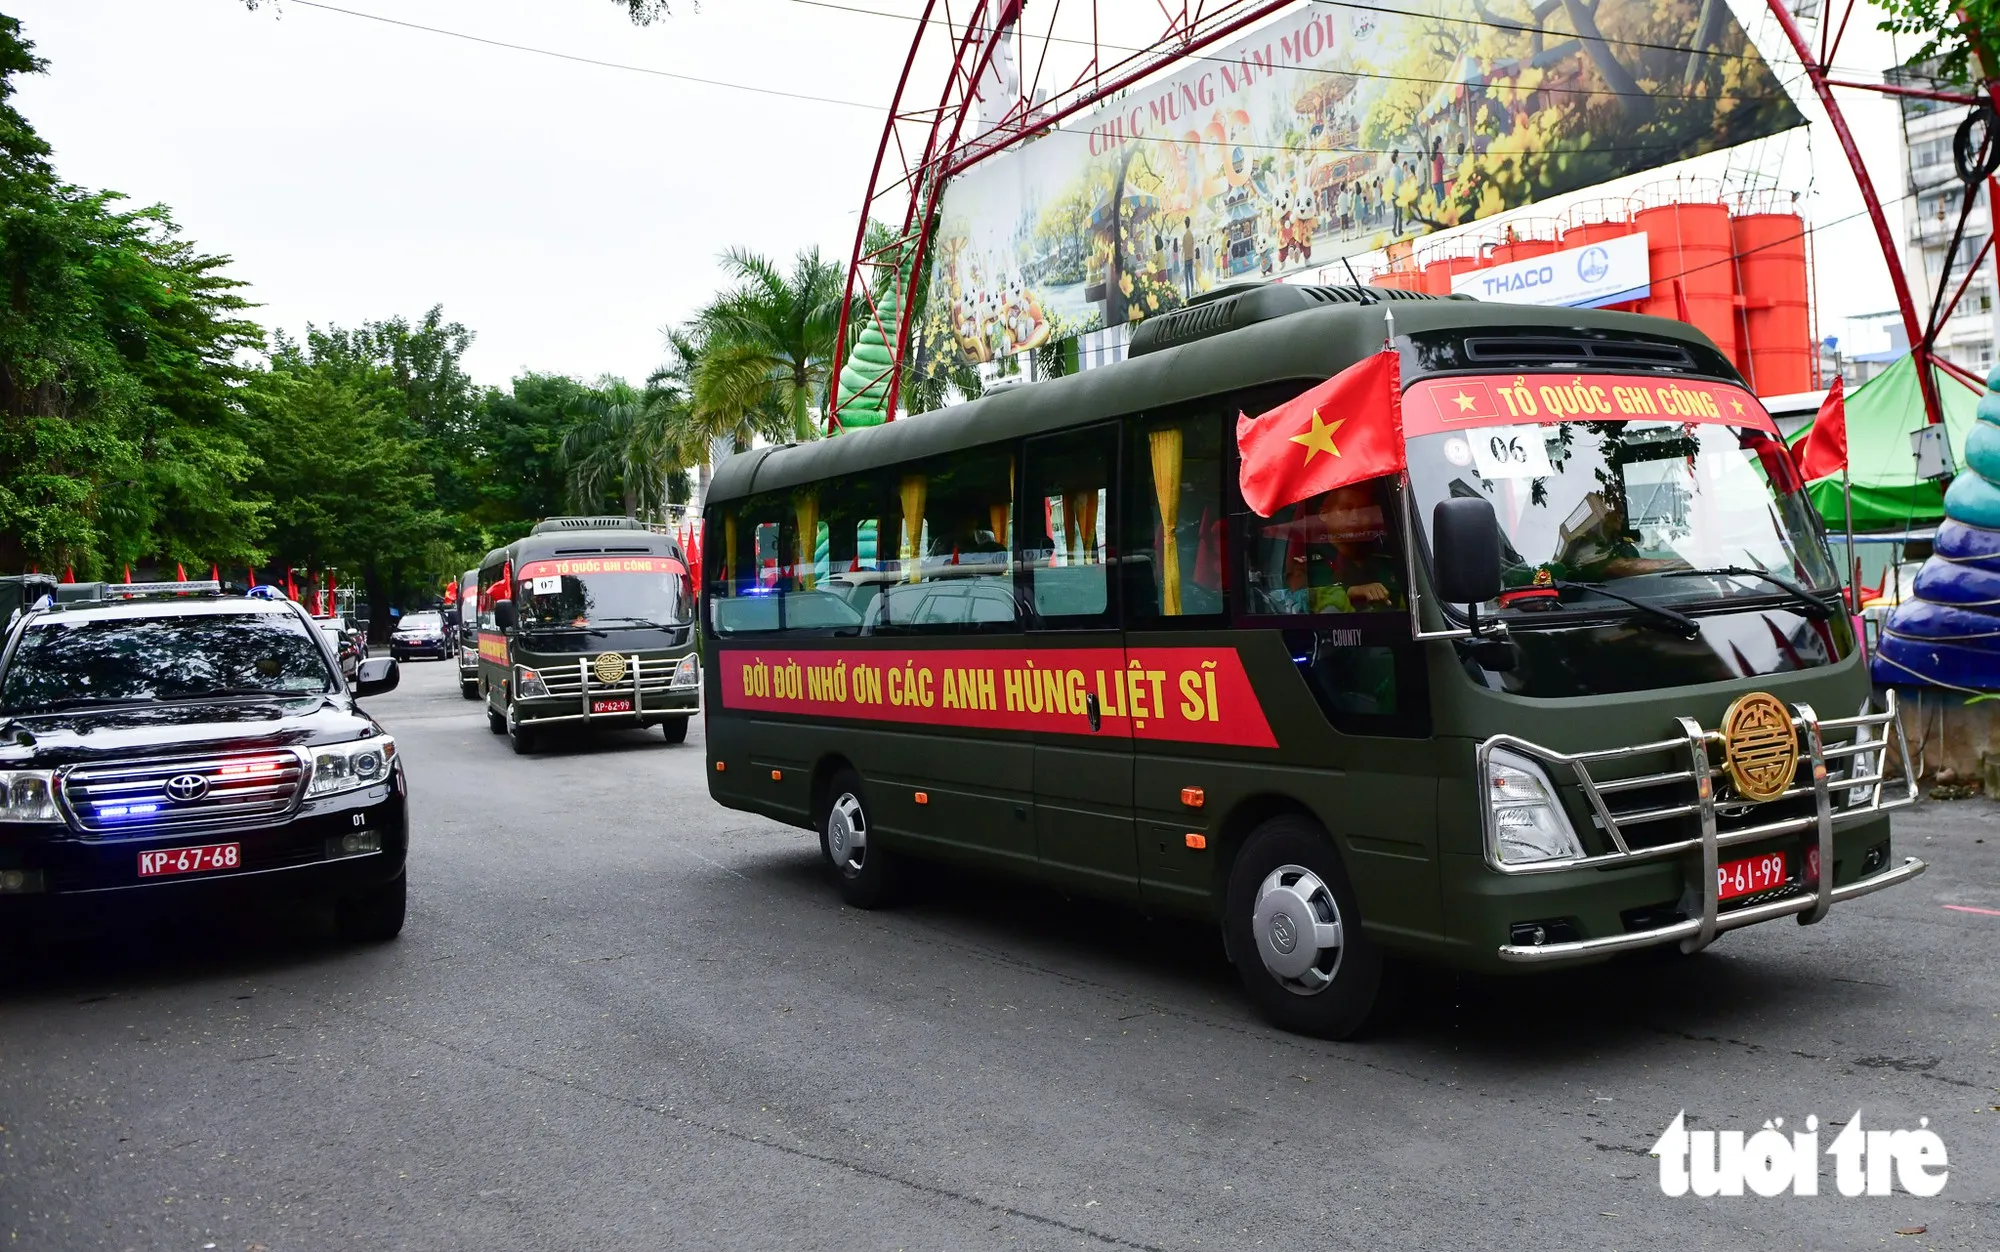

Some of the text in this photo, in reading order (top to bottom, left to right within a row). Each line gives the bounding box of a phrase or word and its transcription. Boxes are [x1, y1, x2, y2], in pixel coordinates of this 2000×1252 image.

[1089, 12, 1334, 157] CHÚC MỪNG NĂM MỚI
[1482, 266, 1553, 296] THACO
[1497, 376, 1721, 419] TỔ QUỐC GHI CÔNG
[1490, 436, 1527, 463] 06
[604, 561, 620, 571] GHI
[624, 560, 652, 571] CÔNG
[541, 581, 554, 590] 07
[1332, 629, 1362, 646] COUNTY
[594, 700, 630, 711] KP-62-99
[743, 657, 1219, 729] ĐỜI ĐỜI NHỚ ƠN CÁC ANH HÙNG LIỆT SĨ
[352, 813, 366, 826] 01
[141, 846, 238, 874] KP-67-68
[1717, 856, 1782, 896] P-61-99
